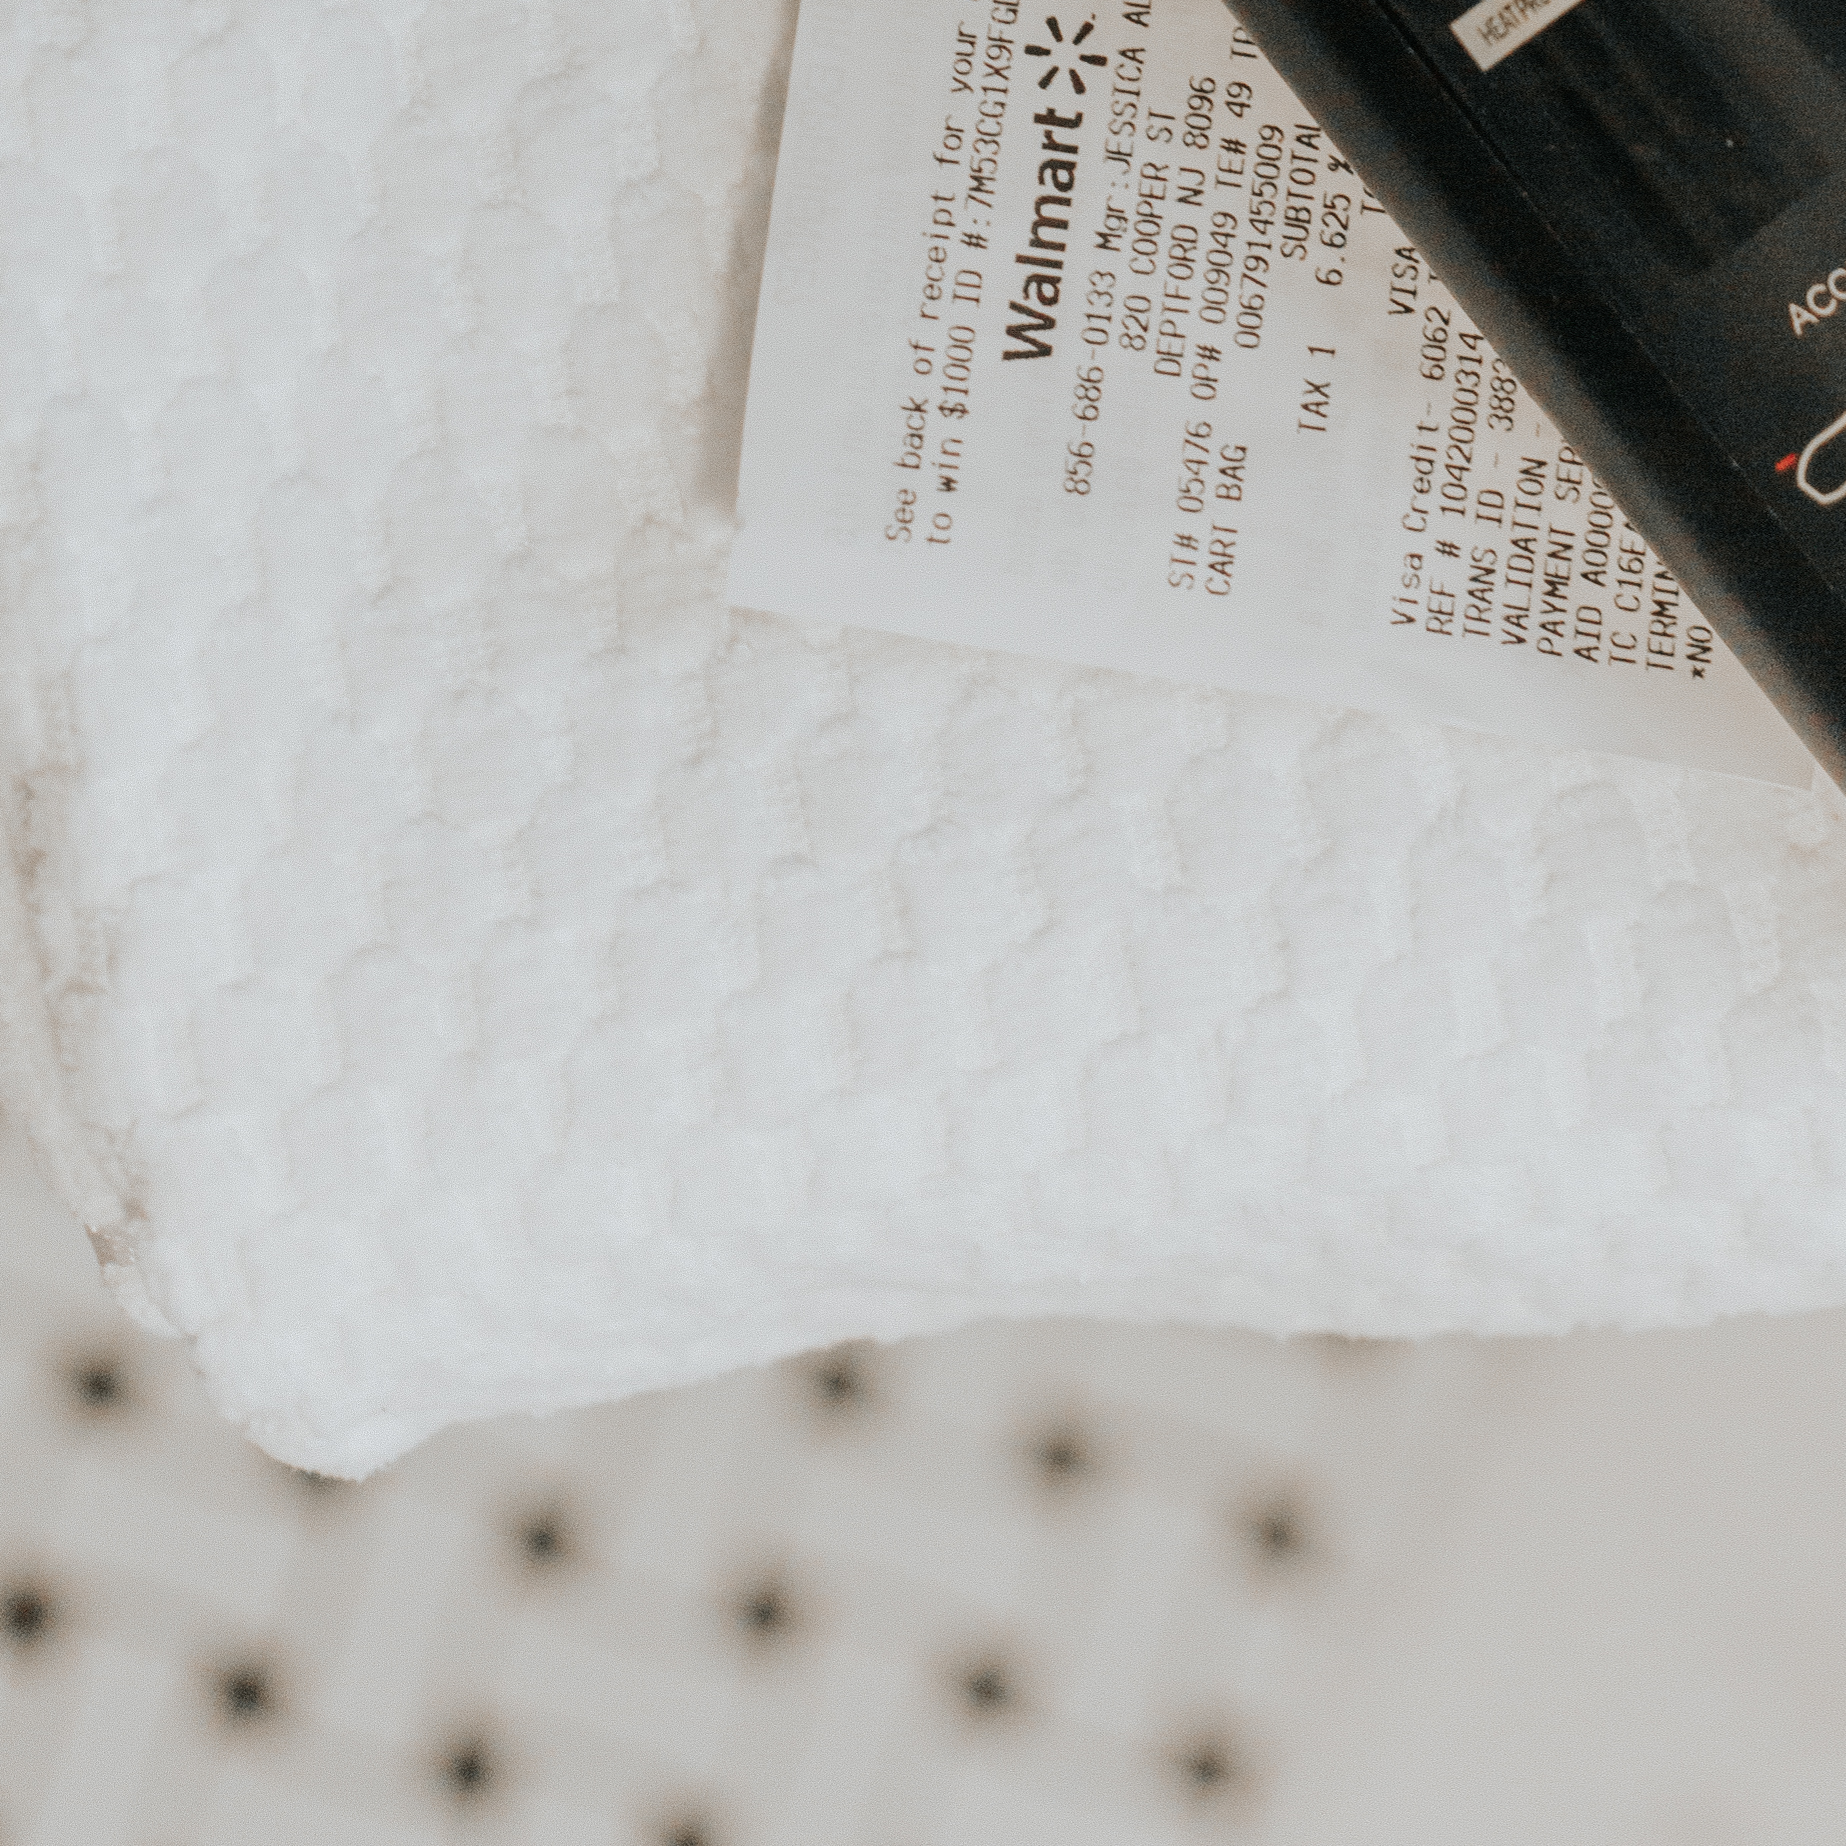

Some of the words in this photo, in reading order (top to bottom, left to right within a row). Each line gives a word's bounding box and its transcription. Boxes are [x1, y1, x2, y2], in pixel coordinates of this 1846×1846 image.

[948, 22, 981, 95] your
[1143, 106, 1177, 145] ST
[1180, 74, 1219, 151] 8096
[1222, 79, 1254, 120] 49
[929, 111, 969, 170] for
[1213, 136, 1249, 191] TE#
[1174, 165, 1207, 208] NJ
[1000, 105, 1086, 365] Walmart
[1127, 160, 1171, 277] COOPER
[1232, 122, 1288, 350] 006791455009
[1312, 191, 1354, 288] 6.625
[915, 191, 959, 322] receipt
[950, 267, 984, 307] ID
[1061, 268, 1119, 497] 856-686-0133
[1091, 44, 1150, 253] Mgr:JESSICA
[1197, 209, 1240, 326] 009049
[1386, 244, 1425, 317] VISA
[1117, 292, 1153, 353] 820
[1151, 221, 1201, 379] DEPTFORD
[905, 338, 937, 377] of
[935, 323, 979, 421] $1000
[1188, 342, 1224, 402] OP#
[1305, 344, 1337, 359] 1
[892, 395, 930, 471] back
[1295, 378, 1333, 435] TAX
[1436, 330, 1492, 518] 1042000314
[932, 436, 964, 494] win
[1174, 419, 1215, 515] 05476
[1213, 442, 1249, 503] BAG
[1388, 550, 1425, 627] Visa
[1417, 304, 1453, 382] 6062
[882, 486, 919, 543] See
[924, 510, 954, 547] to
[1473, 487, 1507, 527] ID
[1165, 531, 1201, 590] ST#
[1202, 521, 1240, 598] CART
[1433, 538, 1462, 559] #
[1497, 455, 1551, 647] VALIDATION
[1421, 575, 1461, 636] REF
[1460, 545, 1500, 639] TRANS
[1533, 523, 1578, 658] PAYMENT
[1570, 603, 1605, 664] AID
[1606, 630, 1640, 667] TC
